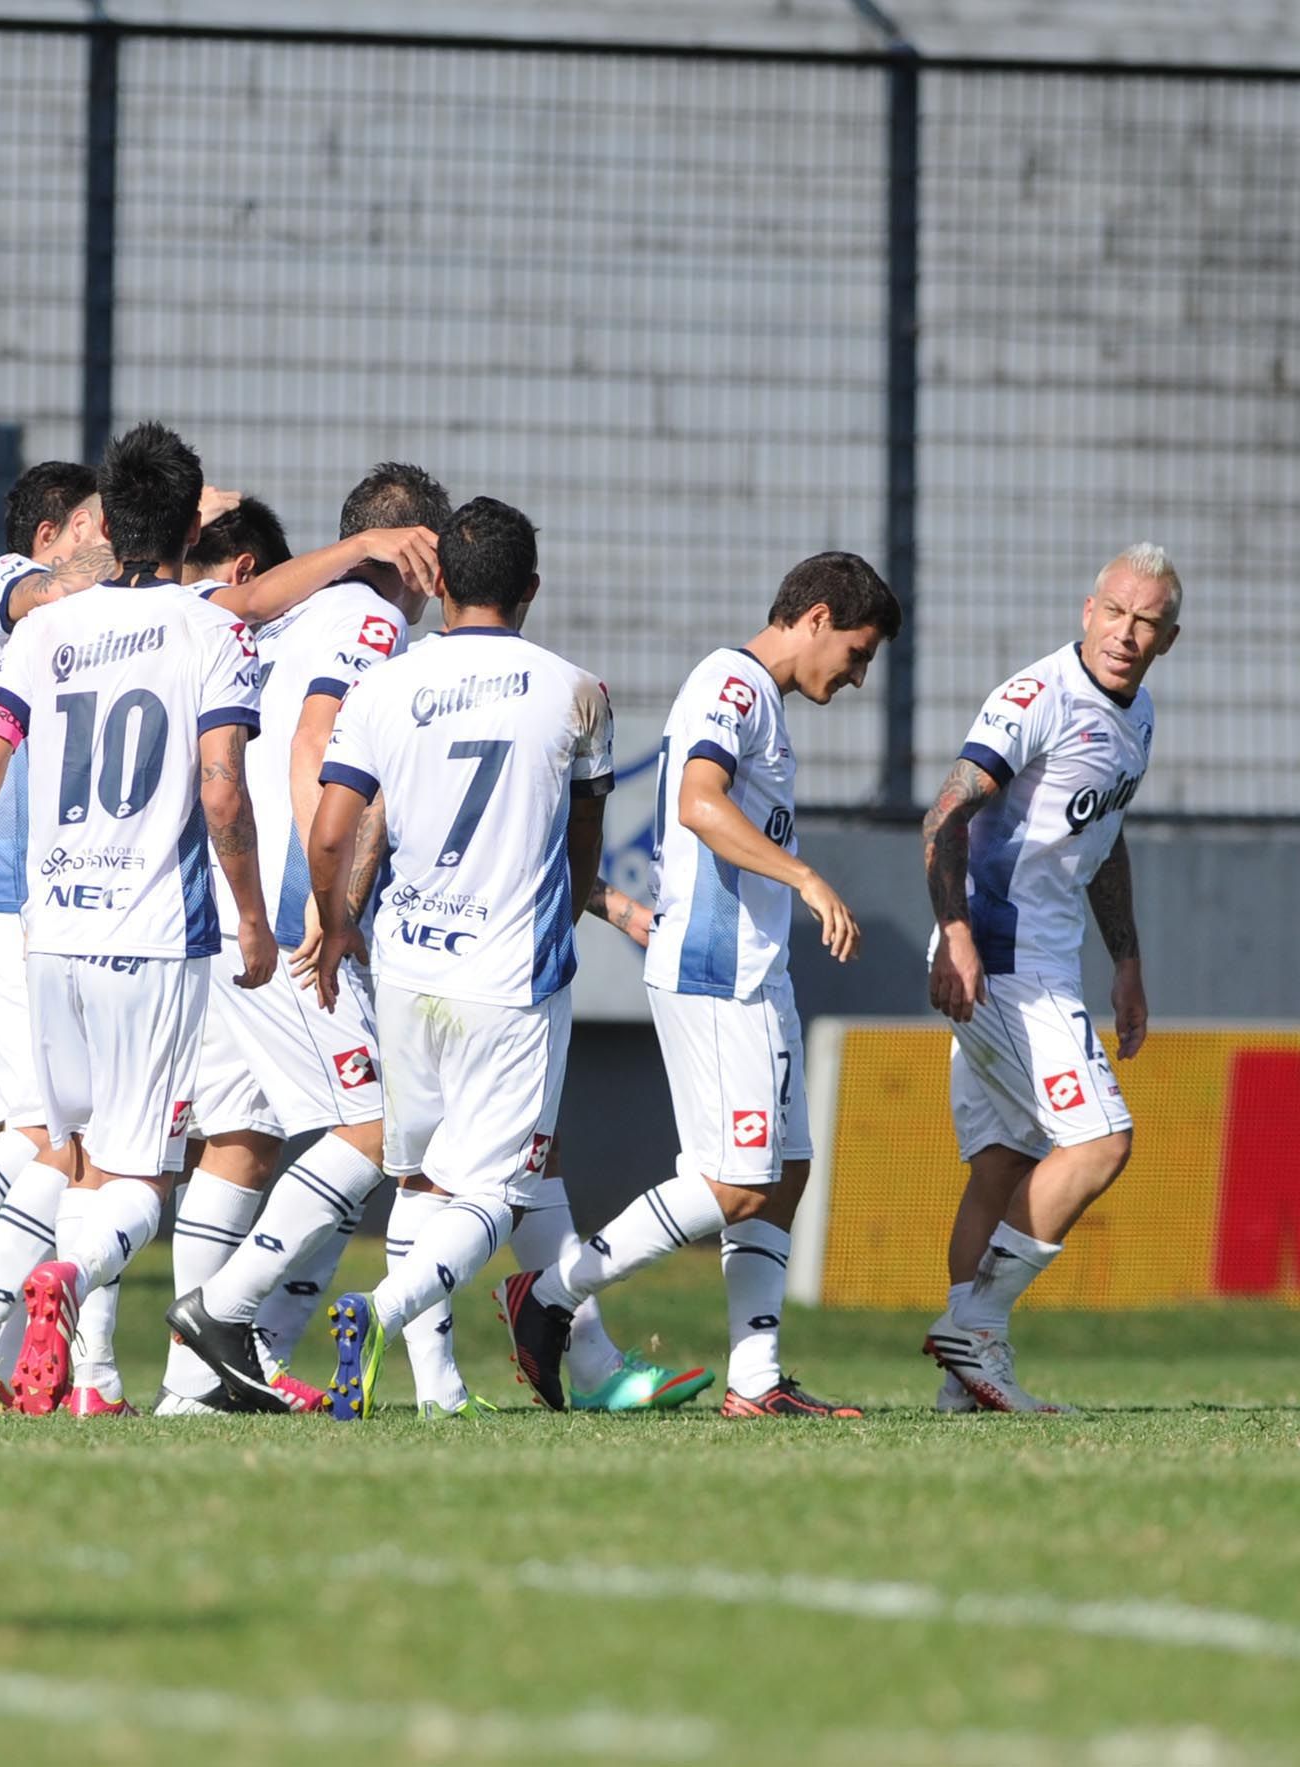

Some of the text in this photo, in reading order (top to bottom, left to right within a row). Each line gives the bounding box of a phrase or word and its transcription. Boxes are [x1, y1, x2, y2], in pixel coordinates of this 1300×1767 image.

[52, 625, 167, 684] Quilmes
[233, 671, 260, 689] NE
[334, 652, 371, 672] NE
[411, 671, 531, 728] Quilmes
[56, 688, 168, 825] 10
[435, 740, 514, 867] 7
[391, 919, 478, 956] NEC
